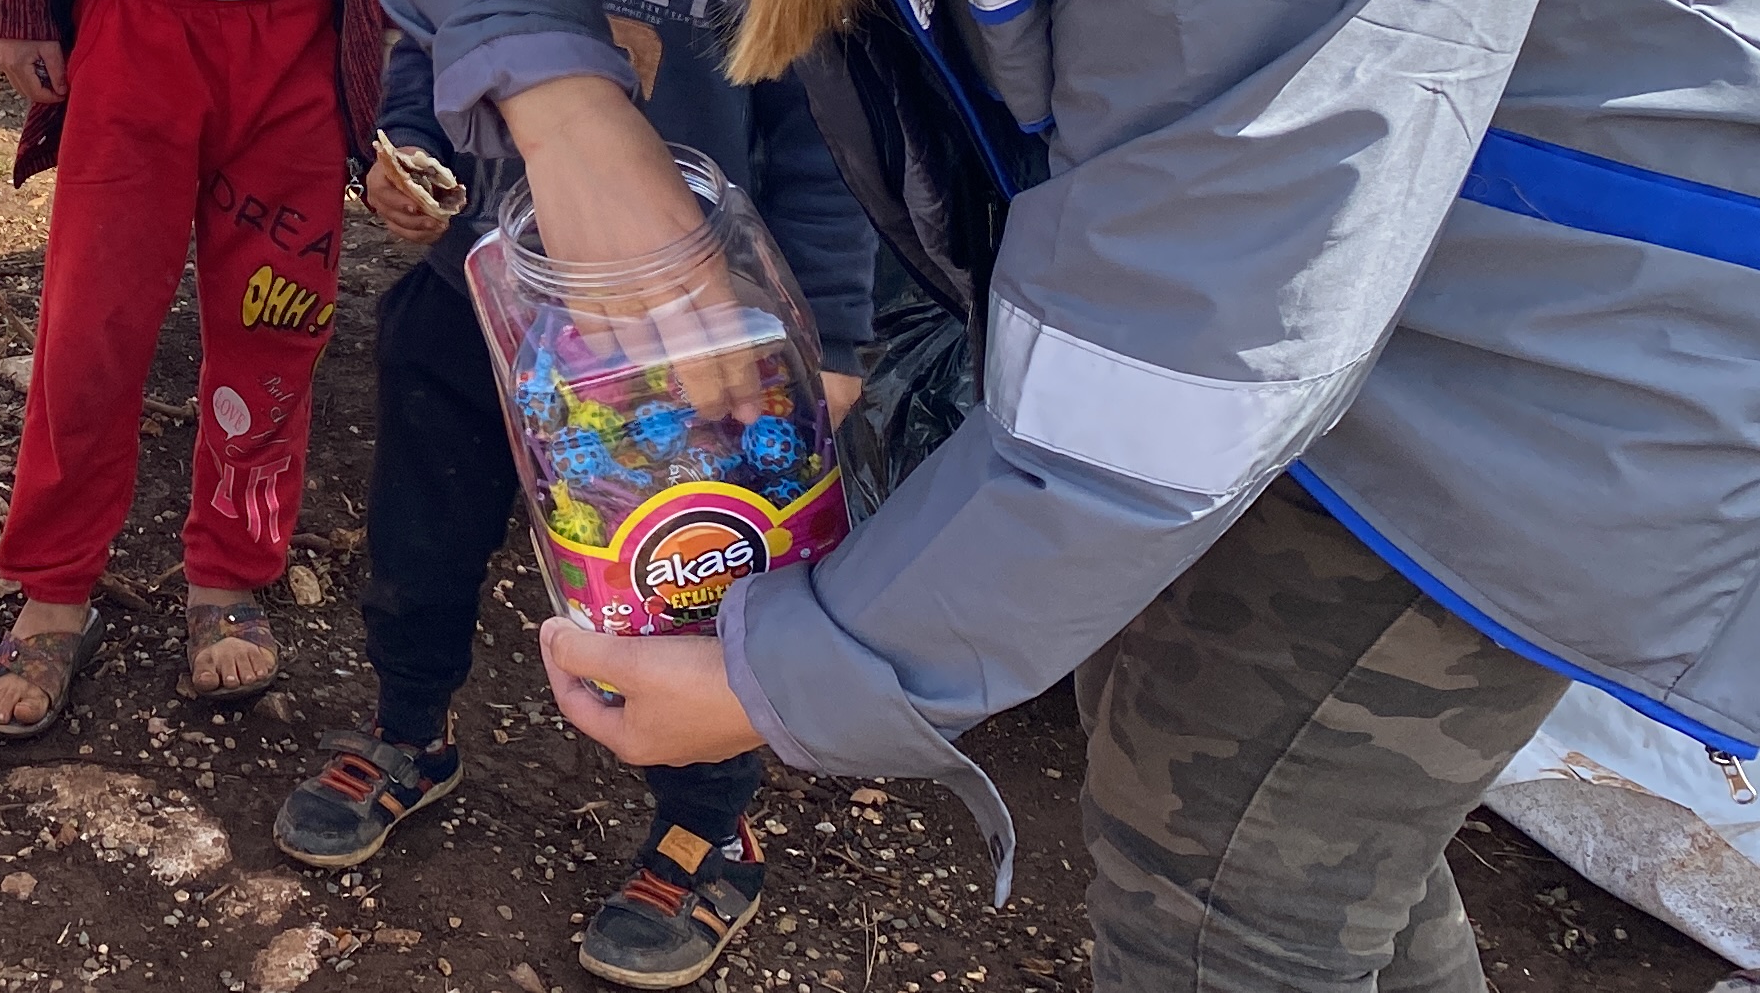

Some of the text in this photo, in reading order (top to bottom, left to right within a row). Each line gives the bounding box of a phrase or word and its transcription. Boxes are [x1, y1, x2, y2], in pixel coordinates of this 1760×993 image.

[209, 169, 340, 273] DREA
[241, 263, 335, 337] OHH!
[214, 391, 246, 432] LOVE
[645, 539, 754, 587] akas
[670, 581, 731, 609] fruit
